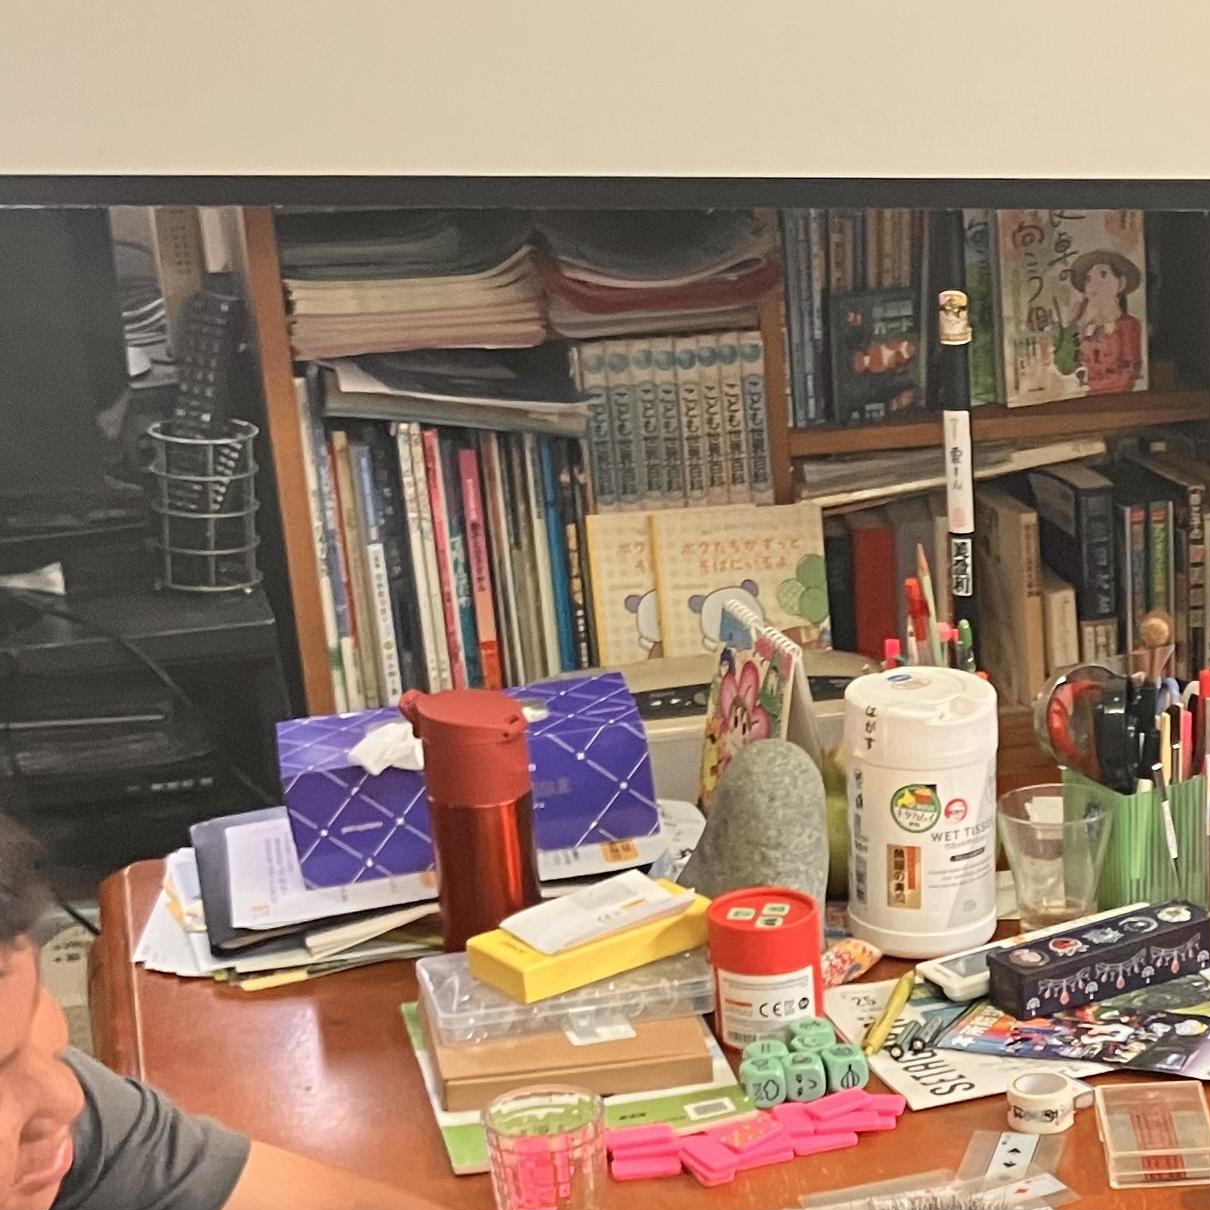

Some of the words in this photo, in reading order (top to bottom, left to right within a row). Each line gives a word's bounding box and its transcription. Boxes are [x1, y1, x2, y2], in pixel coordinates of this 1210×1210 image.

[864, 705, 877, 750] はがす
[931, 830, 960, 842] WET
